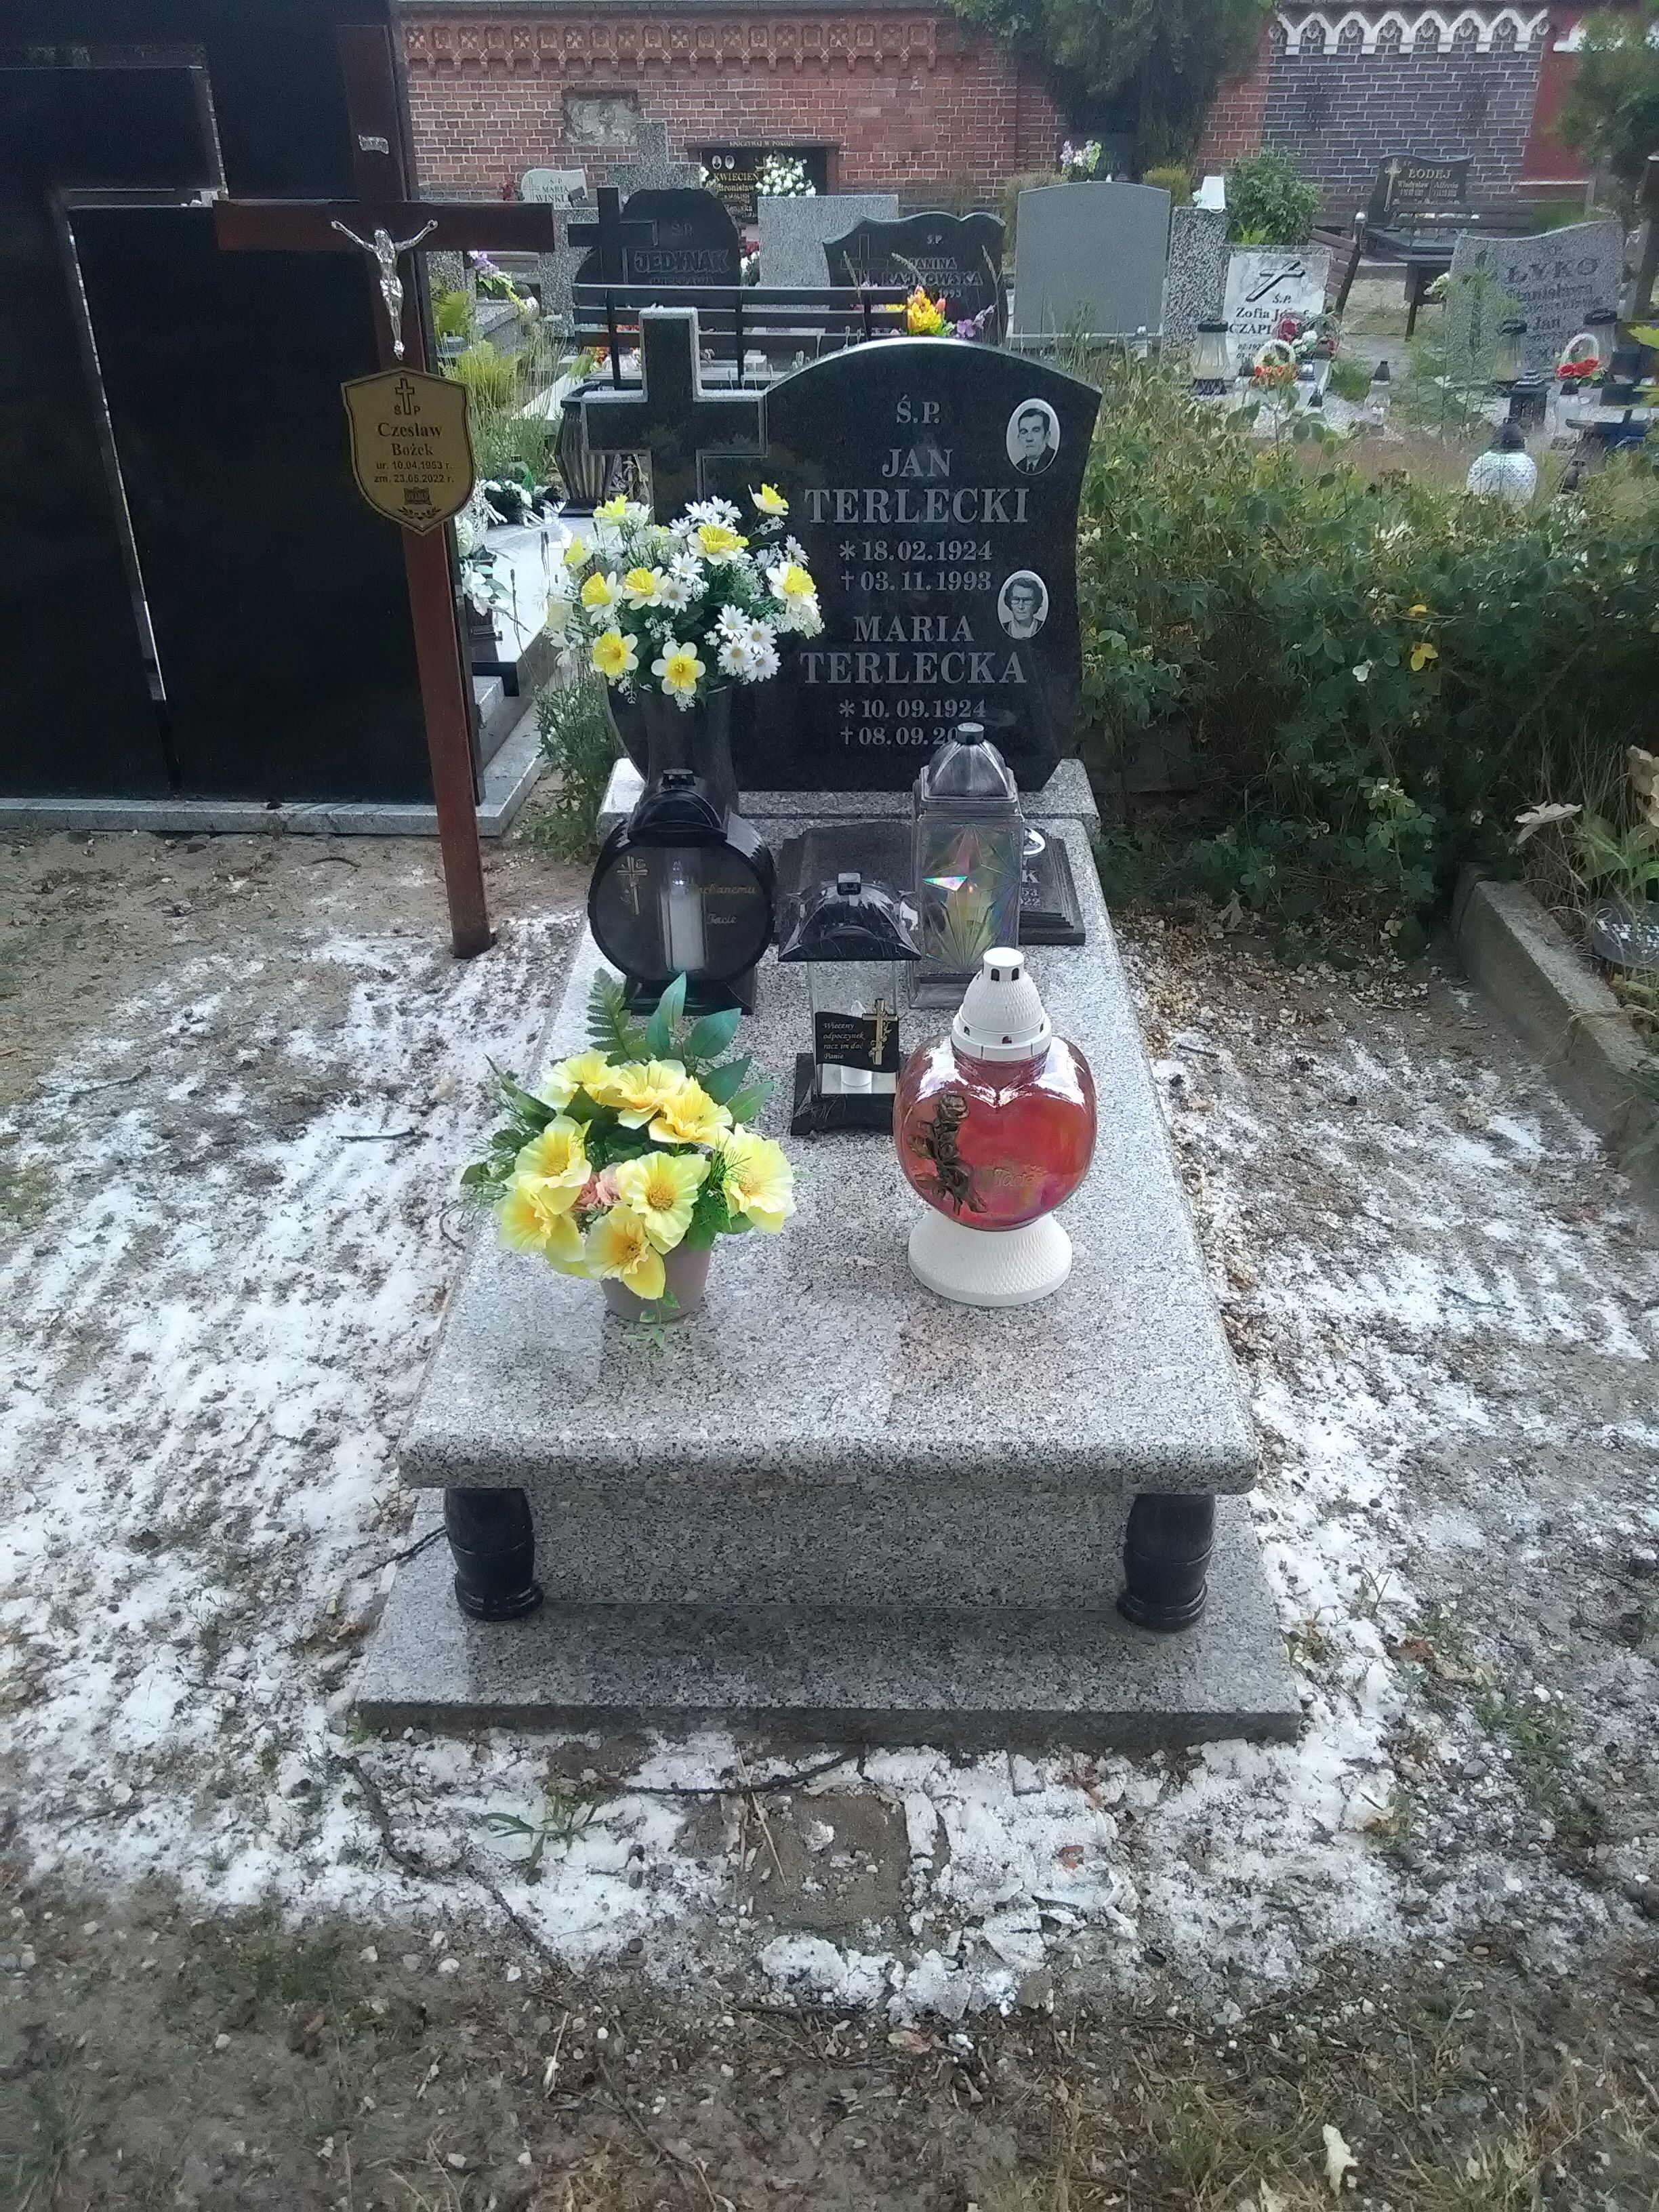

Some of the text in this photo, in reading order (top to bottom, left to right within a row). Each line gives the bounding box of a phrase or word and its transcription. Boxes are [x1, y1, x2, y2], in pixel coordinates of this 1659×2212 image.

[1235, 306, 1270, 319] Zofia
[896, 395, 940, 424] Ś.P.
[392, 443, 434, 456] Bożek
[882, 448, 953, 478] JAN
[804, 487, 1030, 525] TERLECKI
[853, 615, 975, 643] MARIA
[800, 651, 1027, 684] TERLECKA
[859, 726, 958, 745] 08.09.20
[822, 1021, 855, 1030] Wieczny
[823, 1032, 866, 1041] odpoczynek
[823, 1052, 845, 1060] Panie
